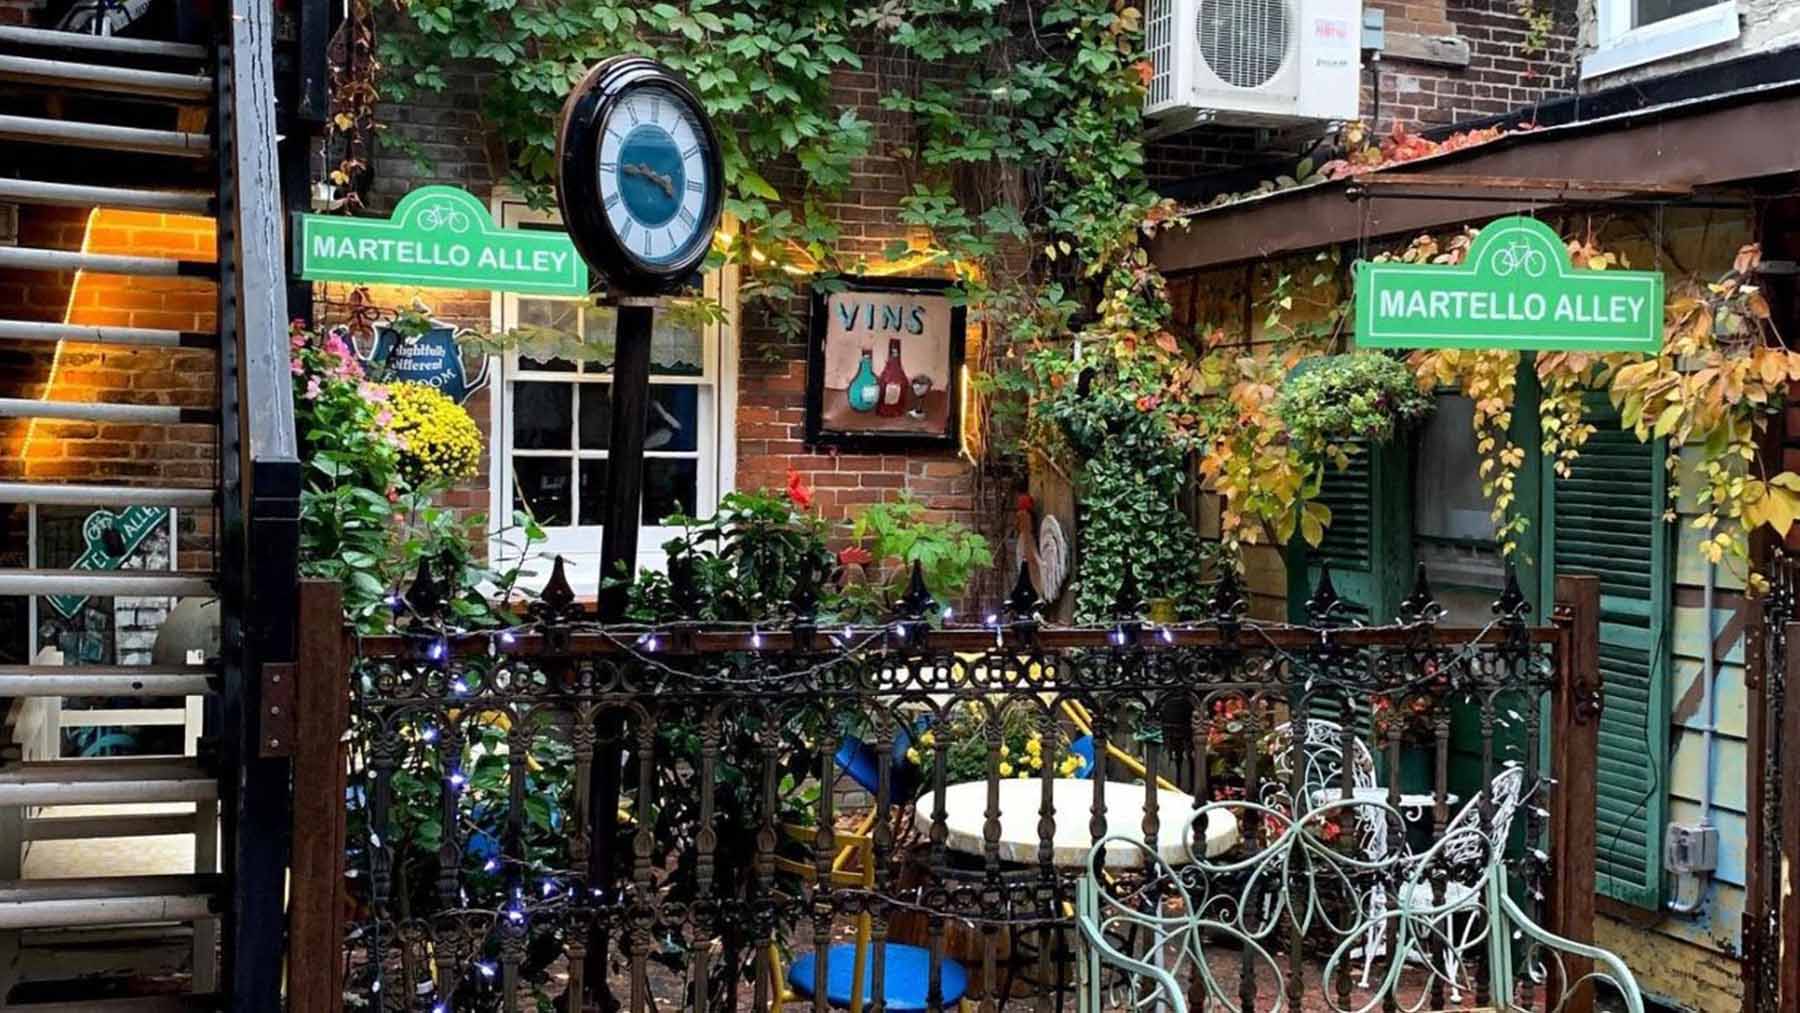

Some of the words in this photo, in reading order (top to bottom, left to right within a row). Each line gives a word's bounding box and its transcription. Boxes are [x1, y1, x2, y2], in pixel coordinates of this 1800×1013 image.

[313, 235, 470, 267] MARTELLO
[477, 246, 567, 273] ALLEY
[837, 302, 926, 335] VINS
[1379, 289, 1546, 321] MARTELLO
[1553, 294, 1645, 323] ALLEY
